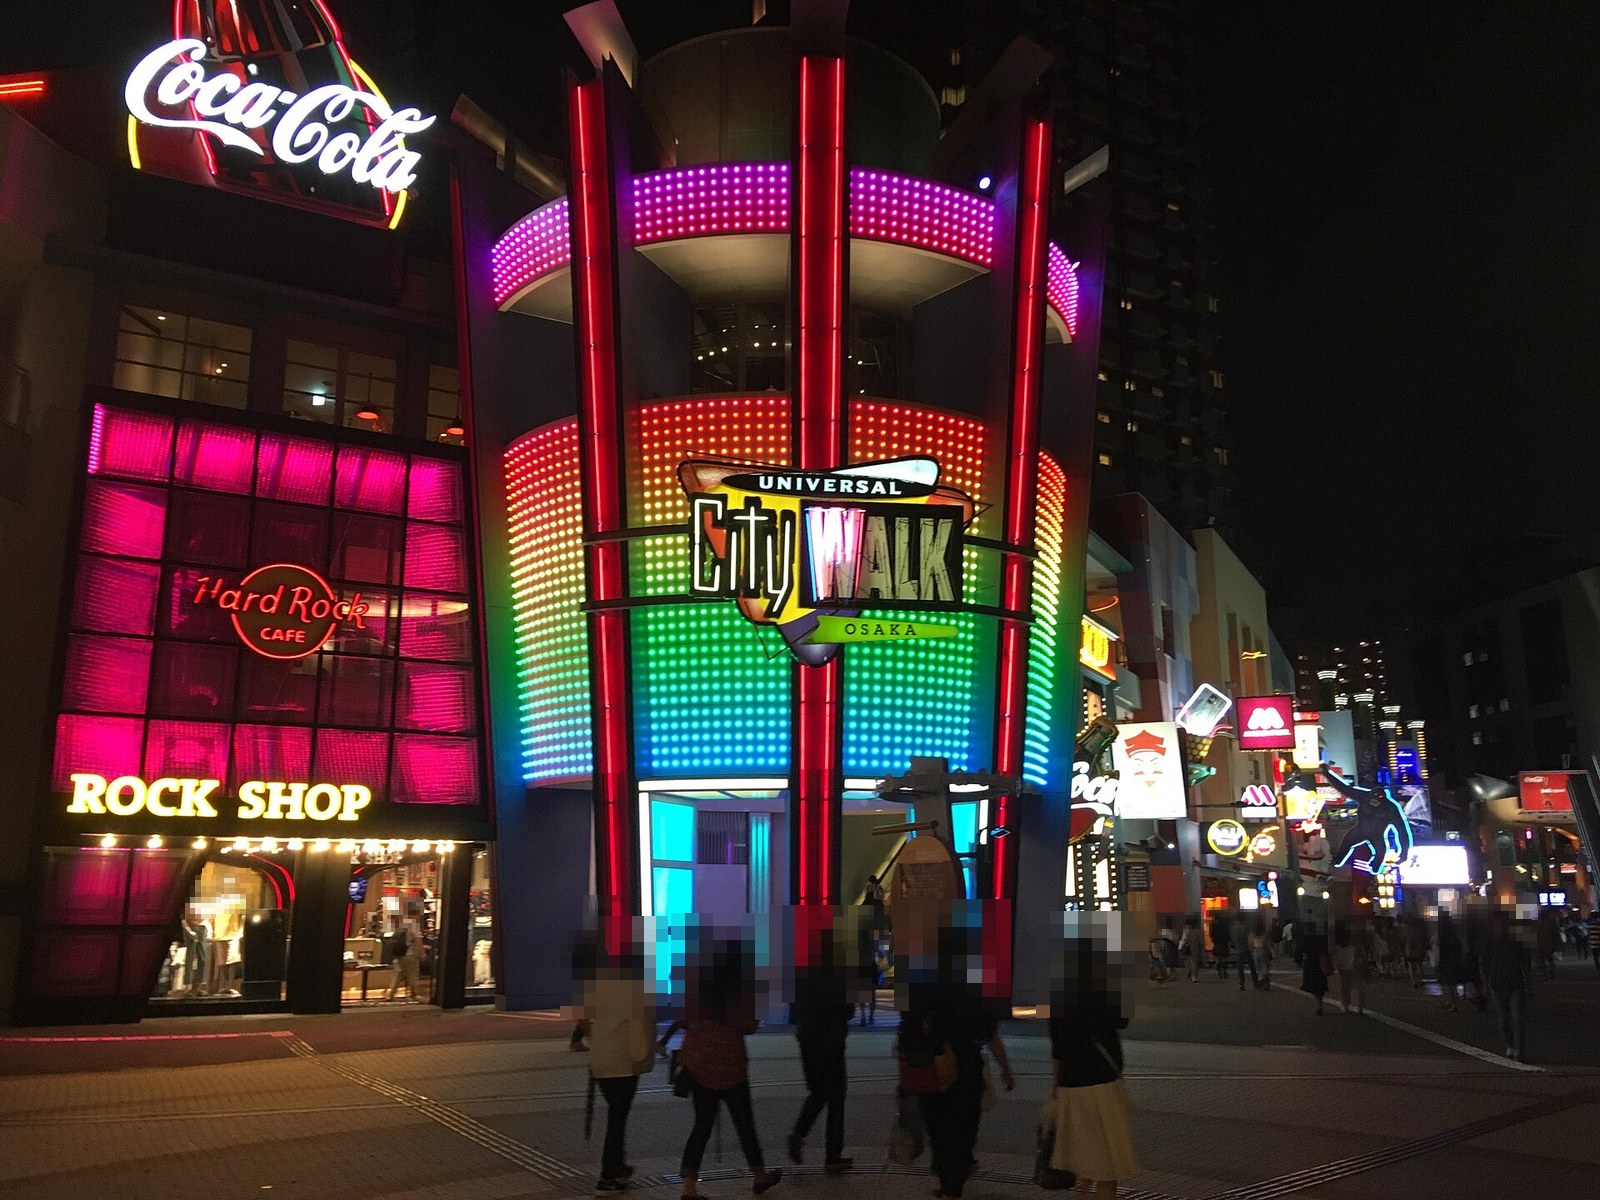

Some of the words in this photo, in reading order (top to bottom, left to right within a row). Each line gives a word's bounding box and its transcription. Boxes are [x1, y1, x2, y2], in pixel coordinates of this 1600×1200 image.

[124, 37, 437, 193] Coca-Cola
[758, 475, 903, 496] UNIVERSAL
[802, 505, 956, 603] WALK
[194, 576, 285, 615] Hard
[288, 586, 371, 630] Rock
[259, 627, 307, 644] CAFE
[844, 622, 917, 637] OSAKA
[67, 773, 220, 818] ROCK
[237, 780, 372, 821] SHOP
